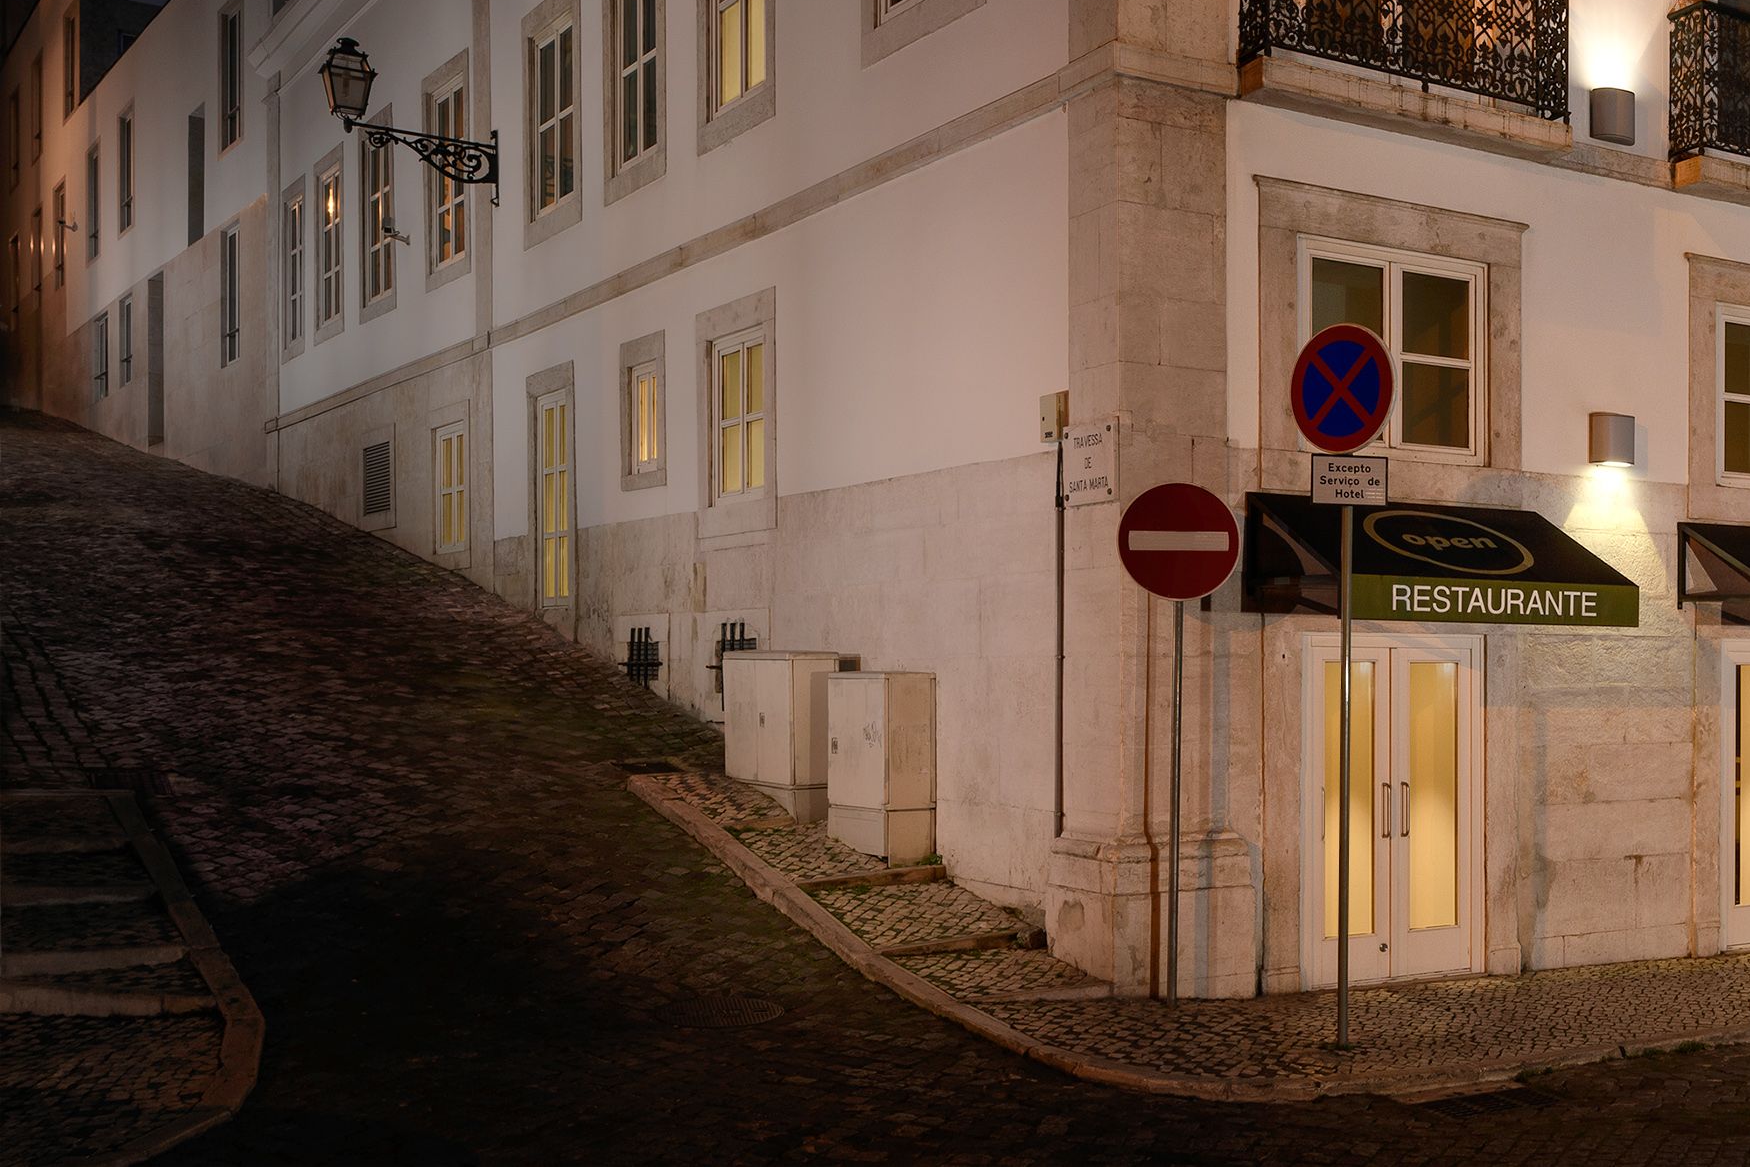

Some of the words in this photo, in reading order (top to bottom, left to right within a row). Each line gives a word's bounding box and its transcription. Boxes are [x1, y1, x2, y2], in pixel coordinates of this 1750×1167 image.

[1073, 433, 1102, 449] TRAVESSA
[1084, 456, 1092, 469] DE
[1328, 462, 1372, 474] Excepto
[1069, 479, 1087, 493] SANTA
[1089, 476, 1108, 490] MARTA
[1319, 475, 1360, 488] Serviço
[1367, 477, 1380, 486] de
[1335, 489, 1365, 499] Hotel
[1401, 533, 1498, 551] open
[1391, 584, 1598, 617] RESTAURANTE
